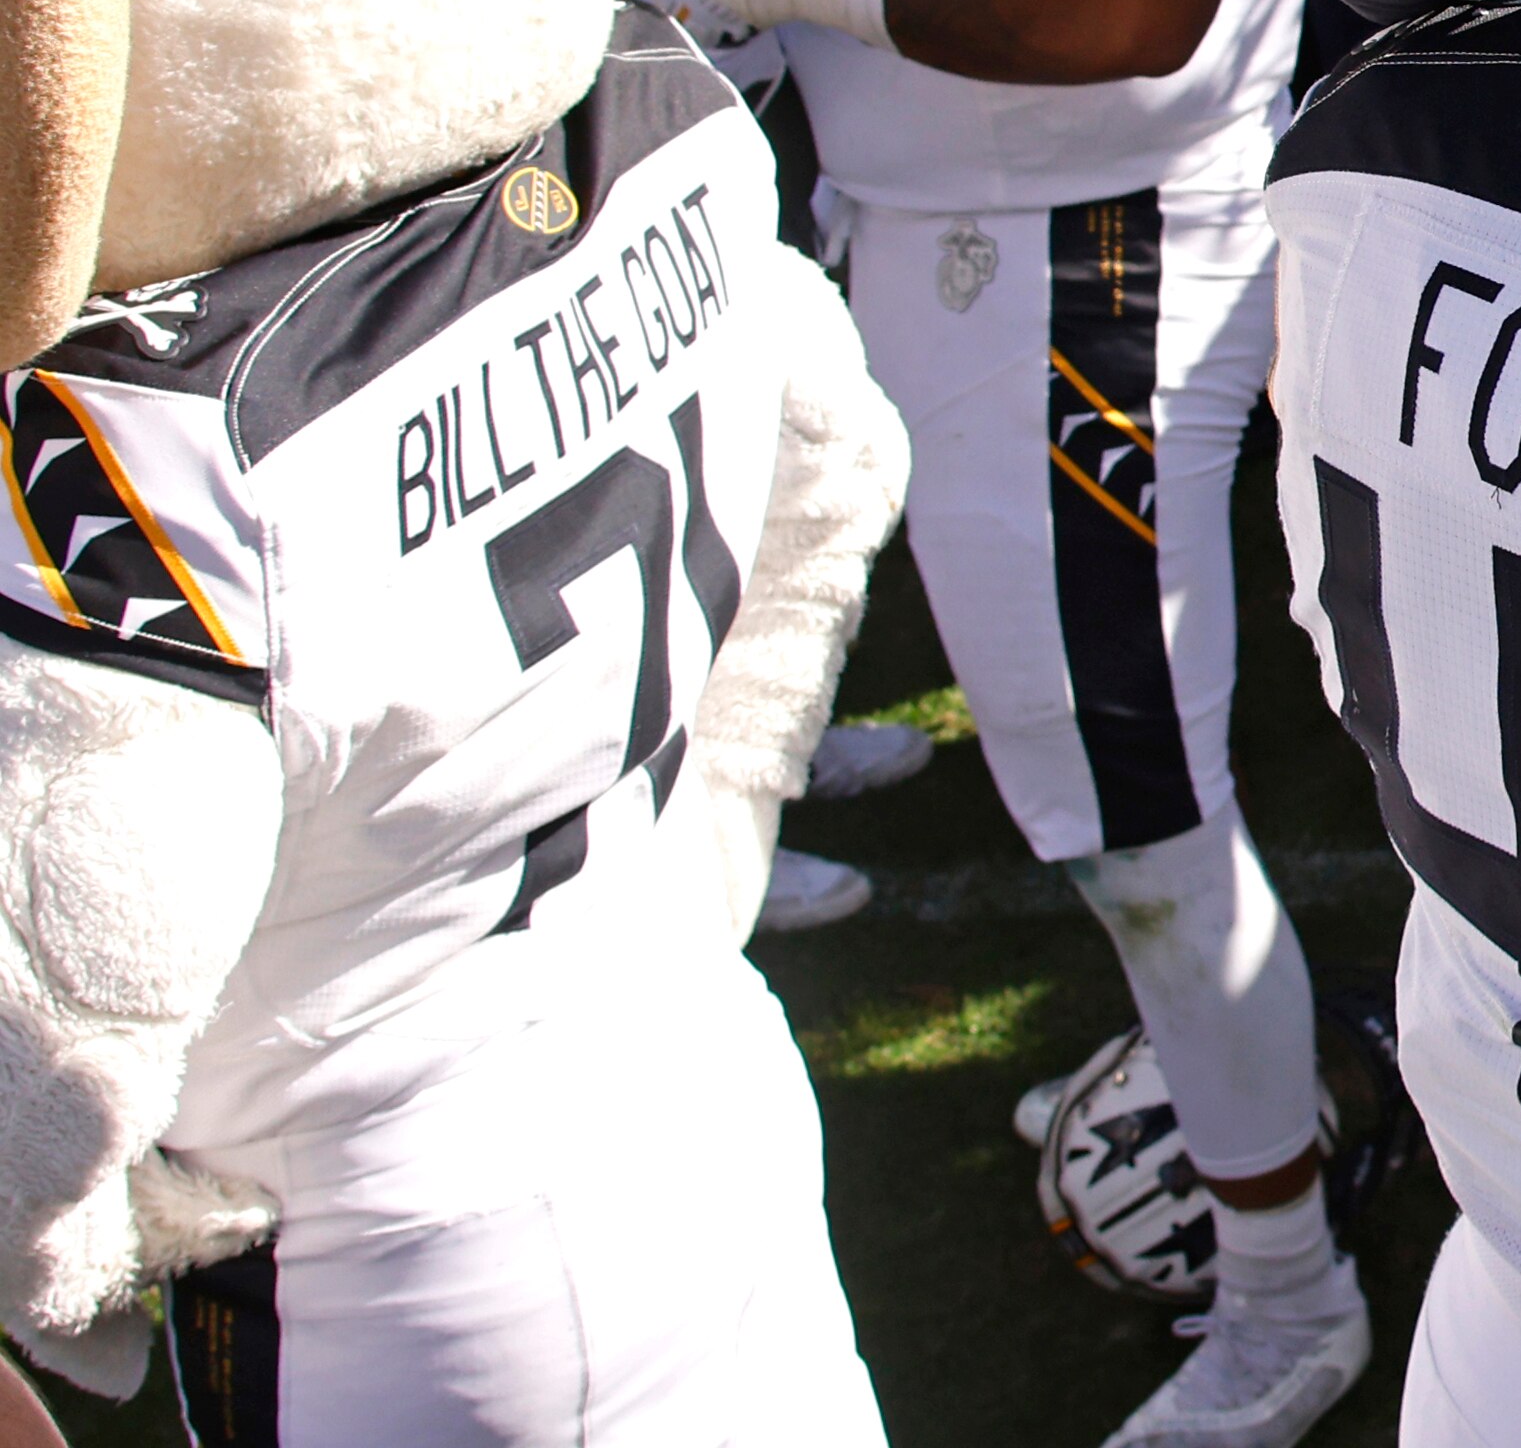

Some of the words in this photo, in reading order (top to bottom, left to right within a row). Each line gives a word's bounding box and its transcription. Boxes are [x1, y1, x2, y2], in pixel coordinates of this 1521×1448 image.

[398, 360, 537, 558] BILL
[513, 274, 640, 460] THE
[620, 182, 730, 374] GOAT
